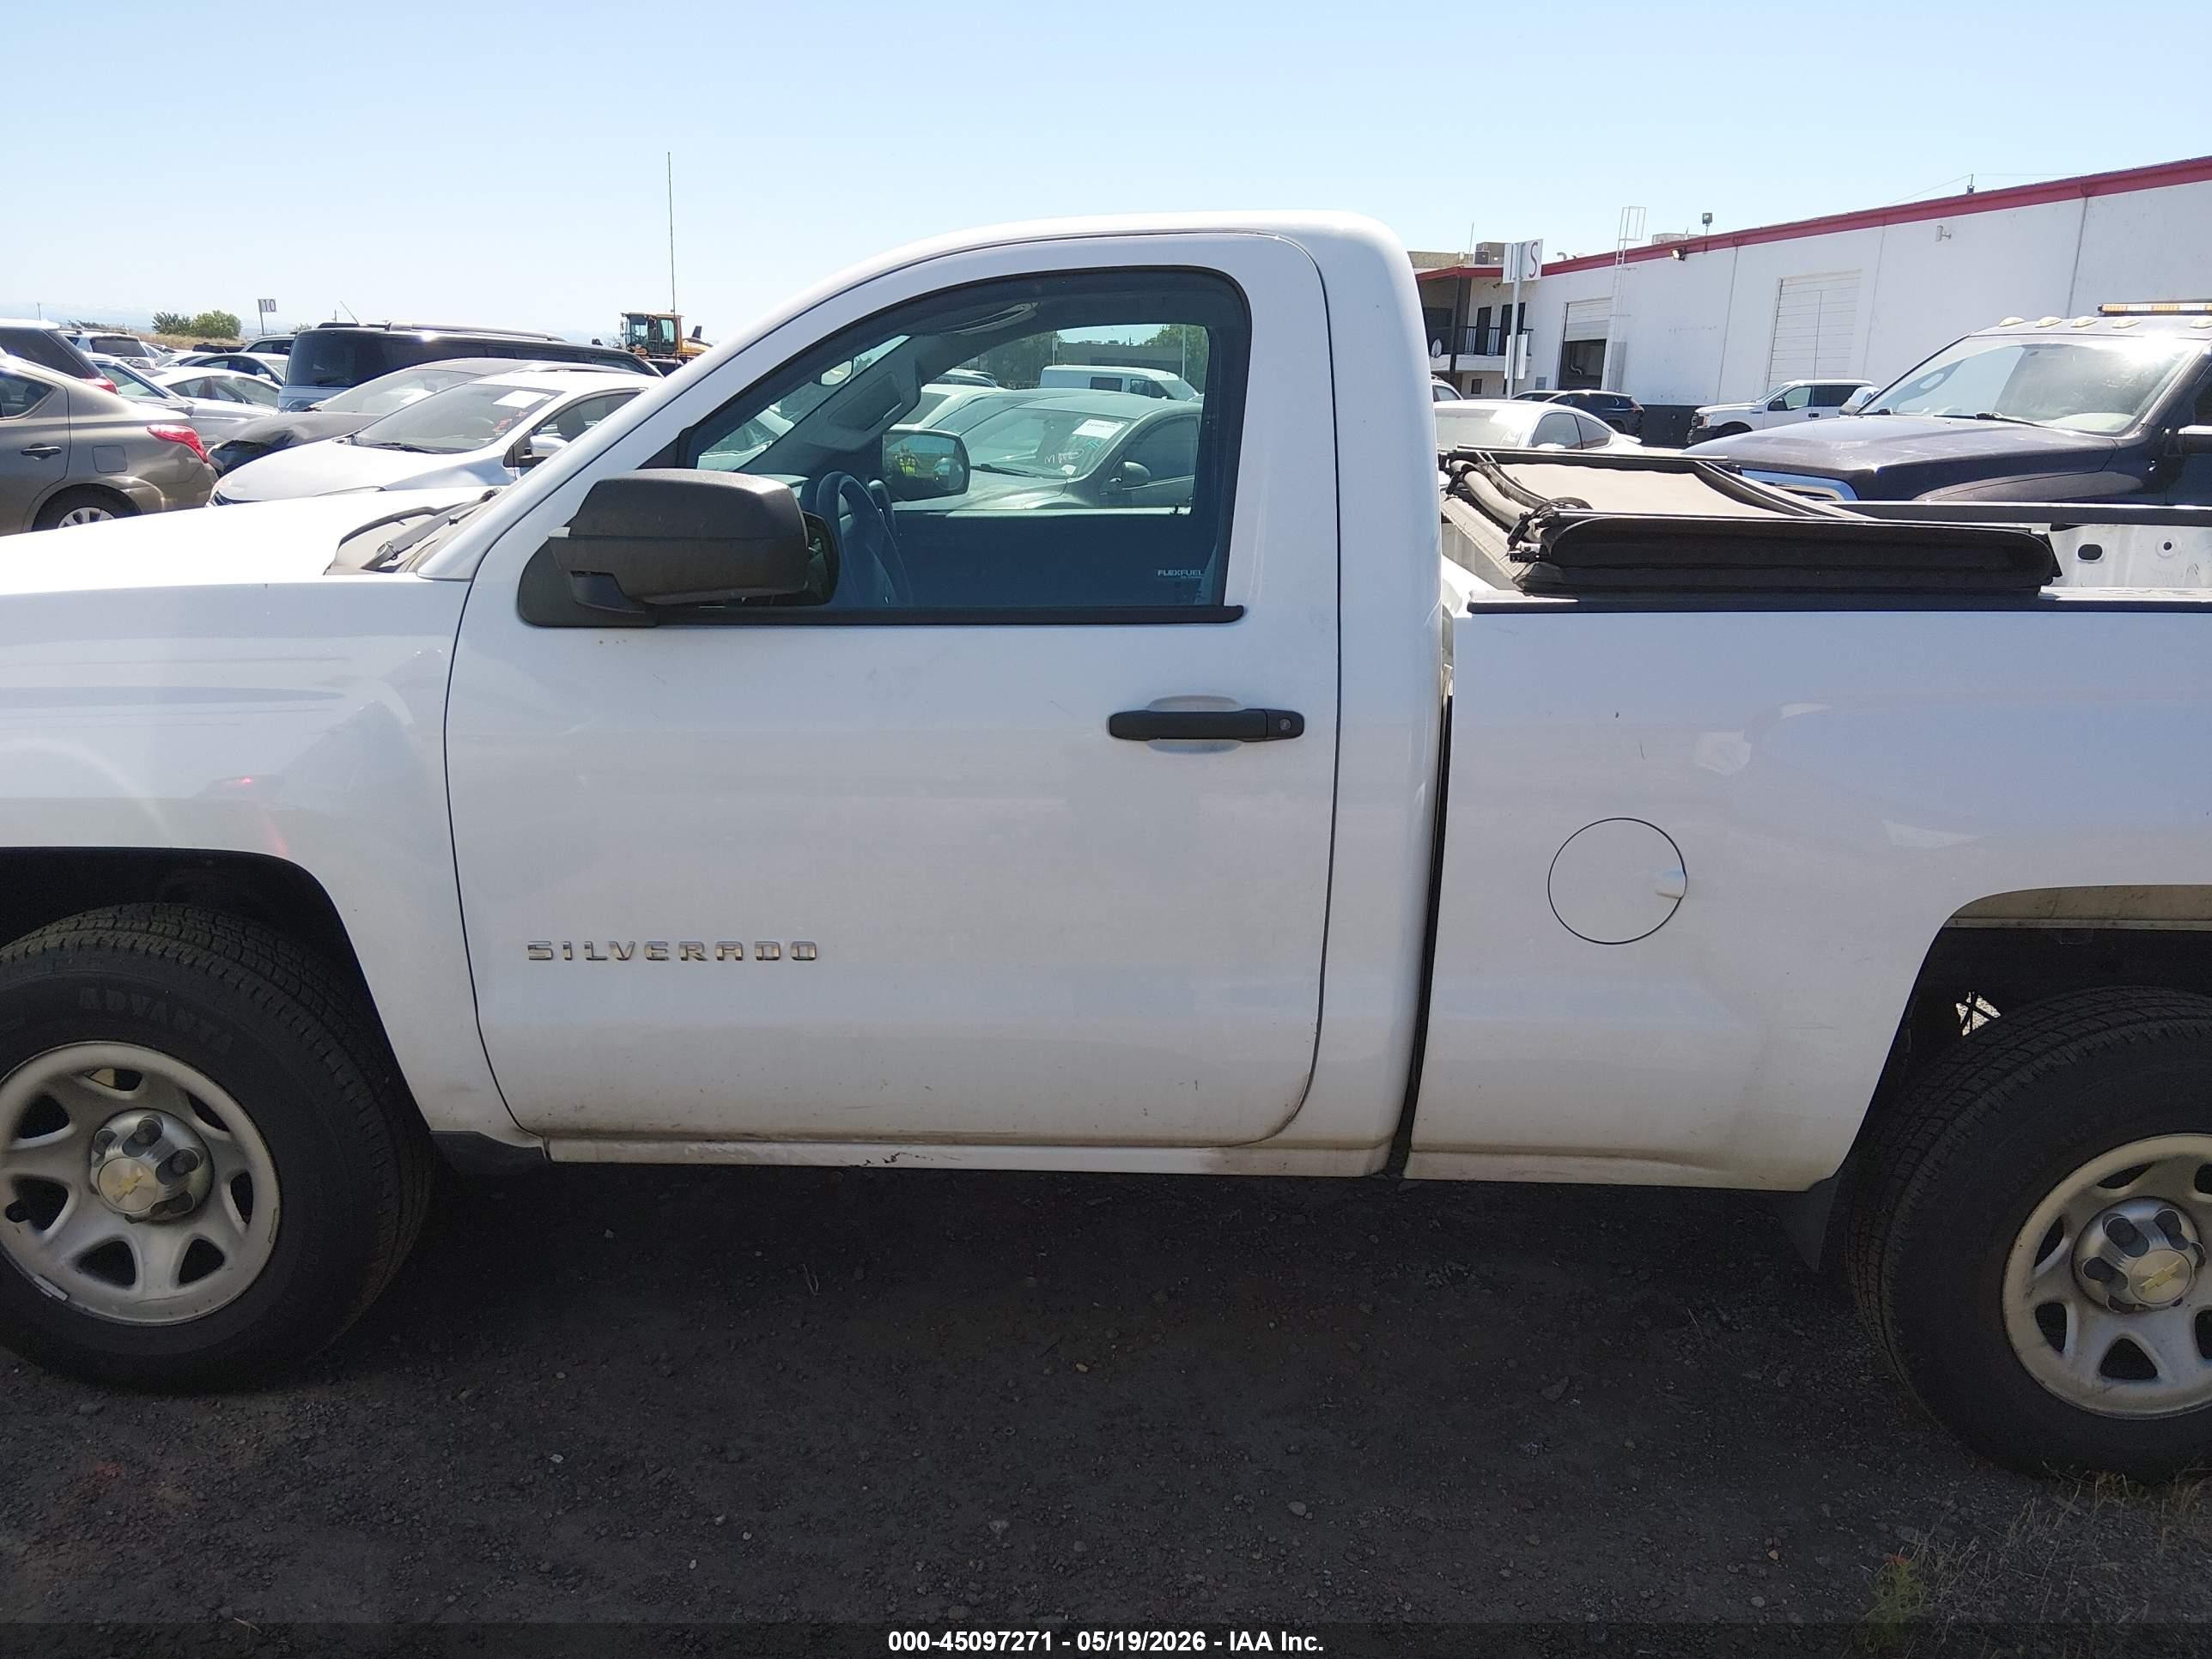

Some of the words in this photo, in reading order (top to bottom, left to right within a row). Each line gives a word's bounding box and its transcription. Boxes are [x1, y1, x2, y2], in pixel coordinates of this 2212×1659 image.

[263, 299, 276, 313] 10
[527, 941, 817, 961] SILVERADO
[78, 987, 233, 1054] ADVANTA
